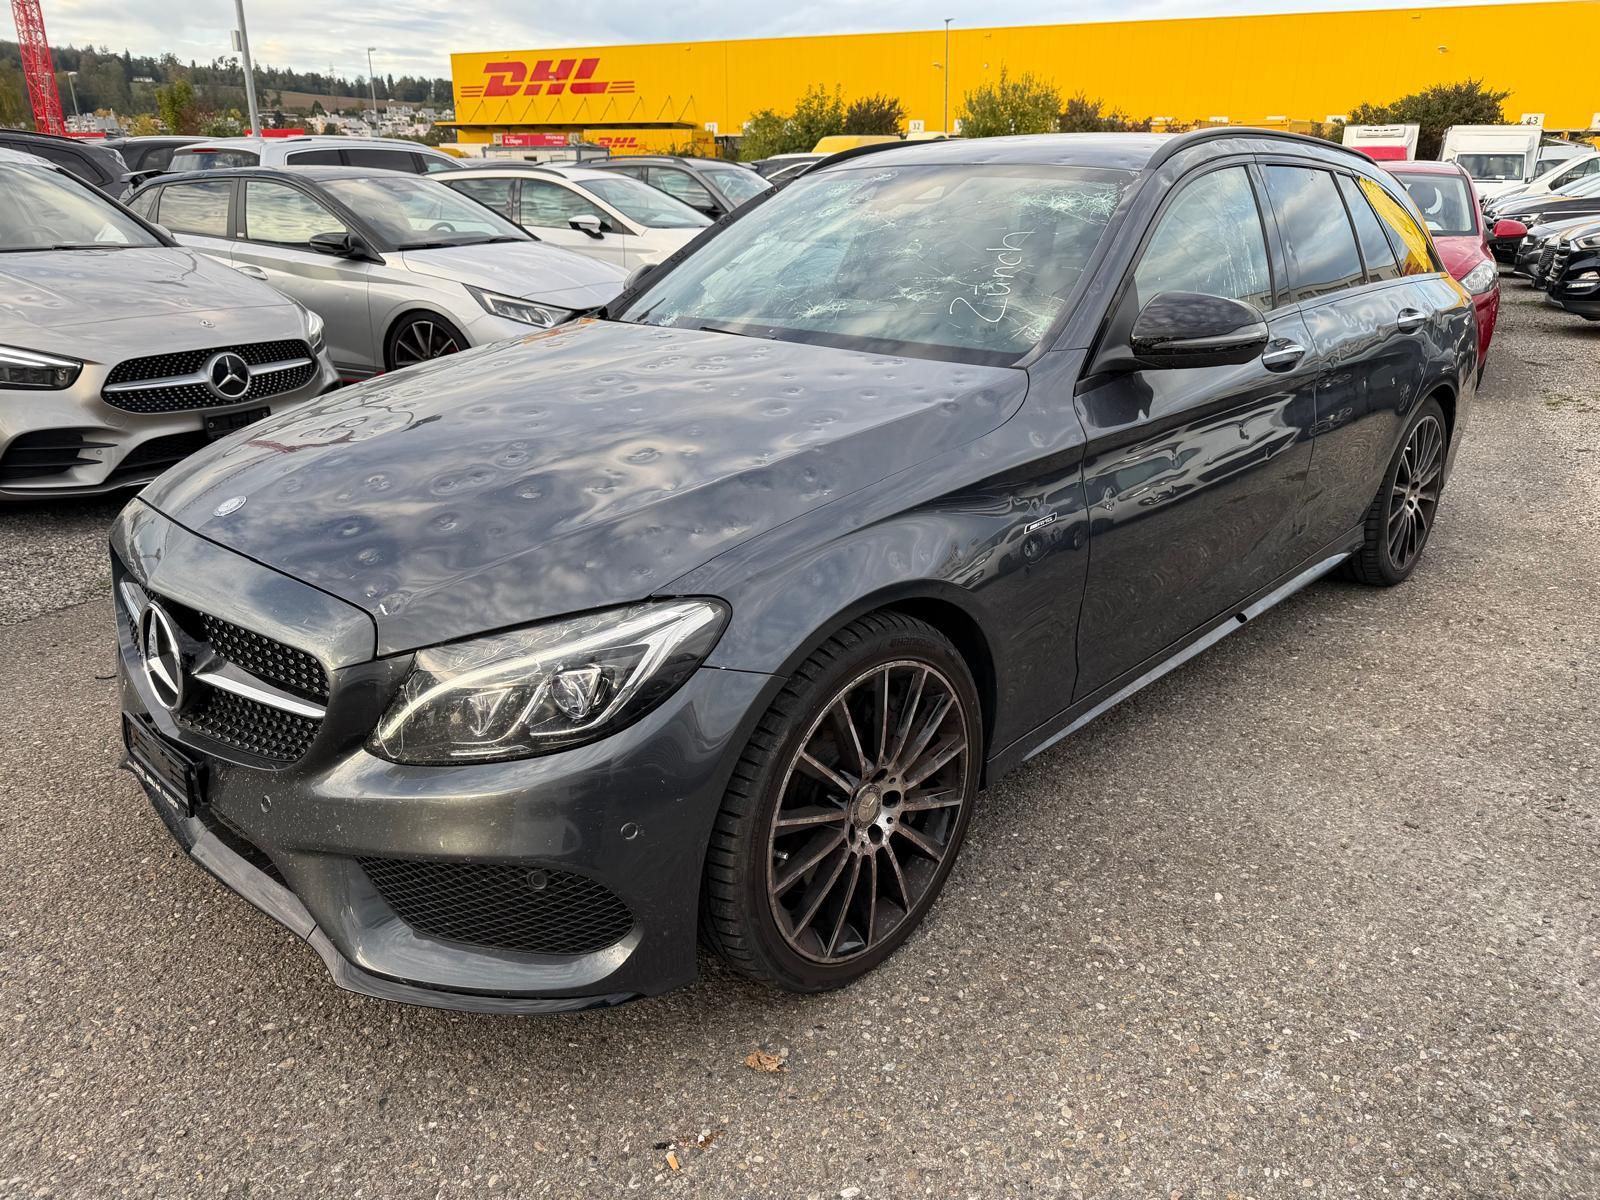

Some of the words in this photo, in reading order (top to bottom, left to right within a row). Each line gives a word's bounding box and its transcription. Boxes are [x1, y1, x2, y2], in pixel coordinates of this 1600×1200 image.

[483, 57, 609, 97] DHL
[1526, 116, 1538, 125] 43
[598, 137, 639, 148] DHL
